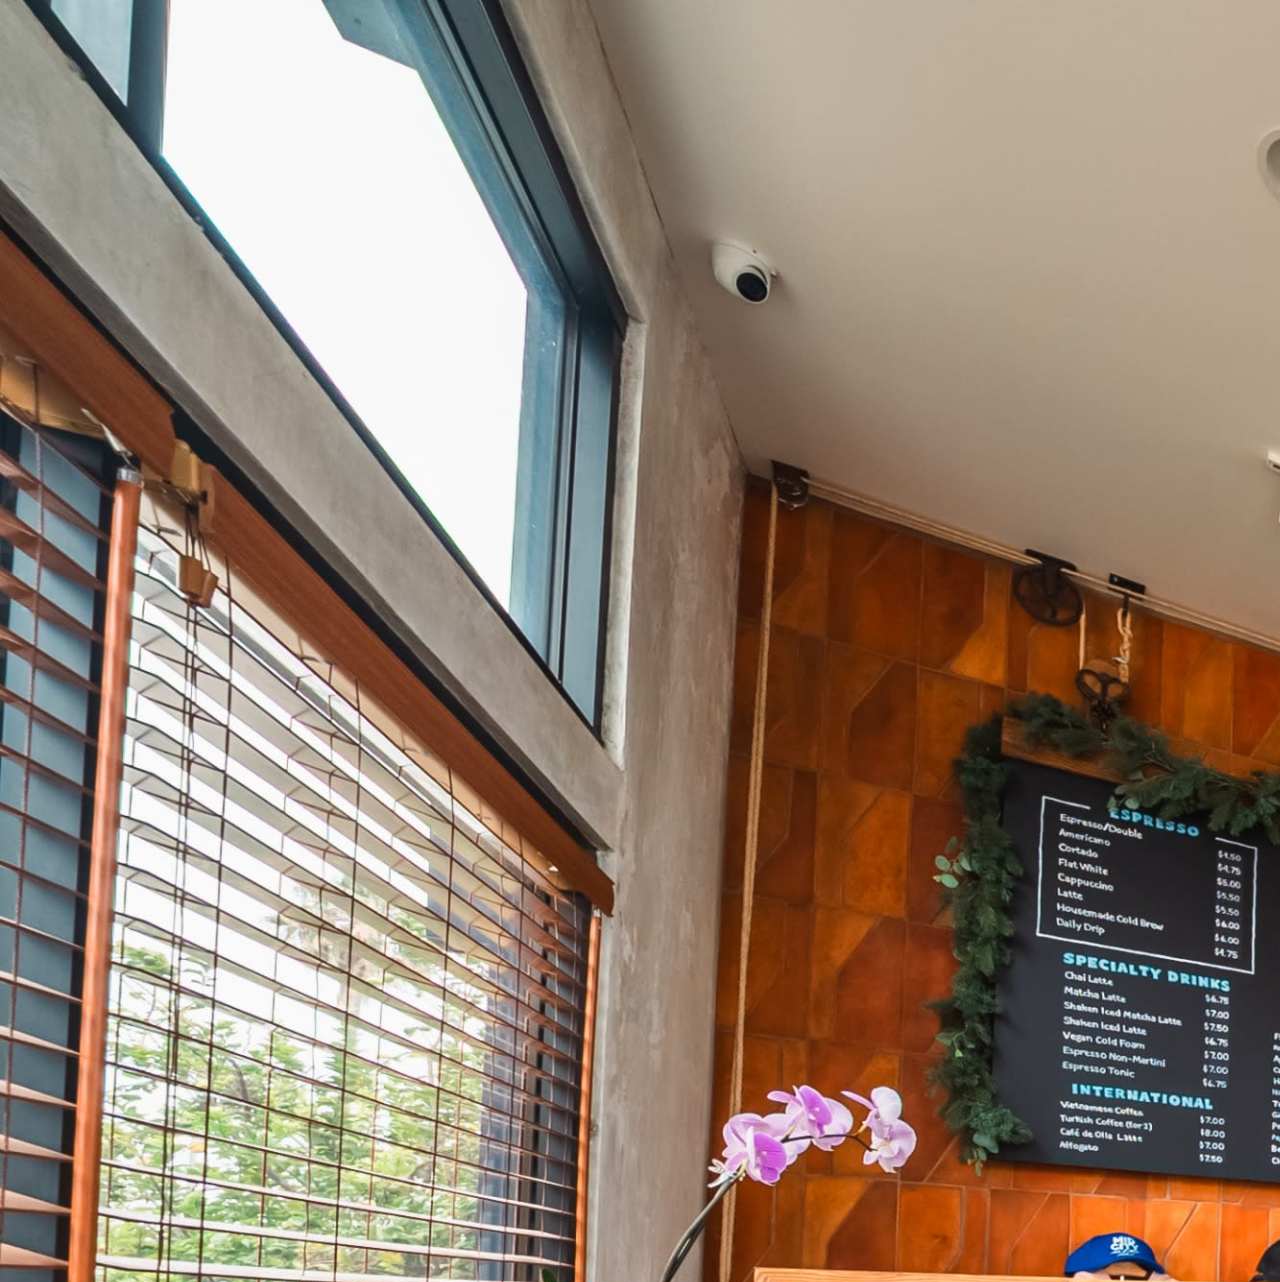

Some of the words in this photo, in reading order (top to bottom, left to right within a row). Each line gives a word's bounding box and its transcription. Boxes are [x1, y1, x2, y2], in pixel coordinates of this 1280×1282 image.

[1060, 813, 1143, 839] Espresso/Double
[1109, 808, 1200, 837] ESPRESSO
[1059, 828, 1110, 846] Americano
[1058, 843, 1098, 858] Cortado
[1058, 858, 1079, 870] Flat
[1080, 862, 1109, 876] White
[1057, 873, 1114, 891] Cappuccino
[1057, 888, 1083, 901] Latte
[1056, 902, 1115, 922] Housemade
[1116, 914, 1139, 926] Cold
[1140, 919, 1164, 931] Brew
[1056, 917, 1082, 931] Daily
[1083, 922, 1105, 936] Drip
[1063, 952, 1162, 981] SPECIALTY
[1167, 970, 1231, 992] DRINKS
[1064, 971, 1086, 982] Chai
[1088, 974, 1113, 987] Latte
[1063, 986, 1100, 1000] Matcha
[1101, 991, 1126, 1003] Latte
[1063, 1001, 1099, 1014] Shaken
[1101, 1006, 1121, 1018] Iced
[1123, 1010, 1156, 1023] Matcha
[1158, 1014, 1182, 1026] Latte
[1062, 1016, 1099, 1029] Shaken
[1101, 1021, 1120, 1033] Iced
[1122, 1024, 1147, 1036] Latte
[1062, 1031, 1093, 1044] Vegan
[1095, 1034, 1118, 1047] Cold
[1119, 1038, 1145, 1050] Foam
[1062, 1046, 1107, 1061] Espresso
[1109, 1052, 1166, 1068] Non-Martini
[1061, 1061, 1106, 1075] Espresso
[1108, 1066, 1135, 1078] Tonic
[1071, 1083, 1213, 1111] INTERNATIONAL
